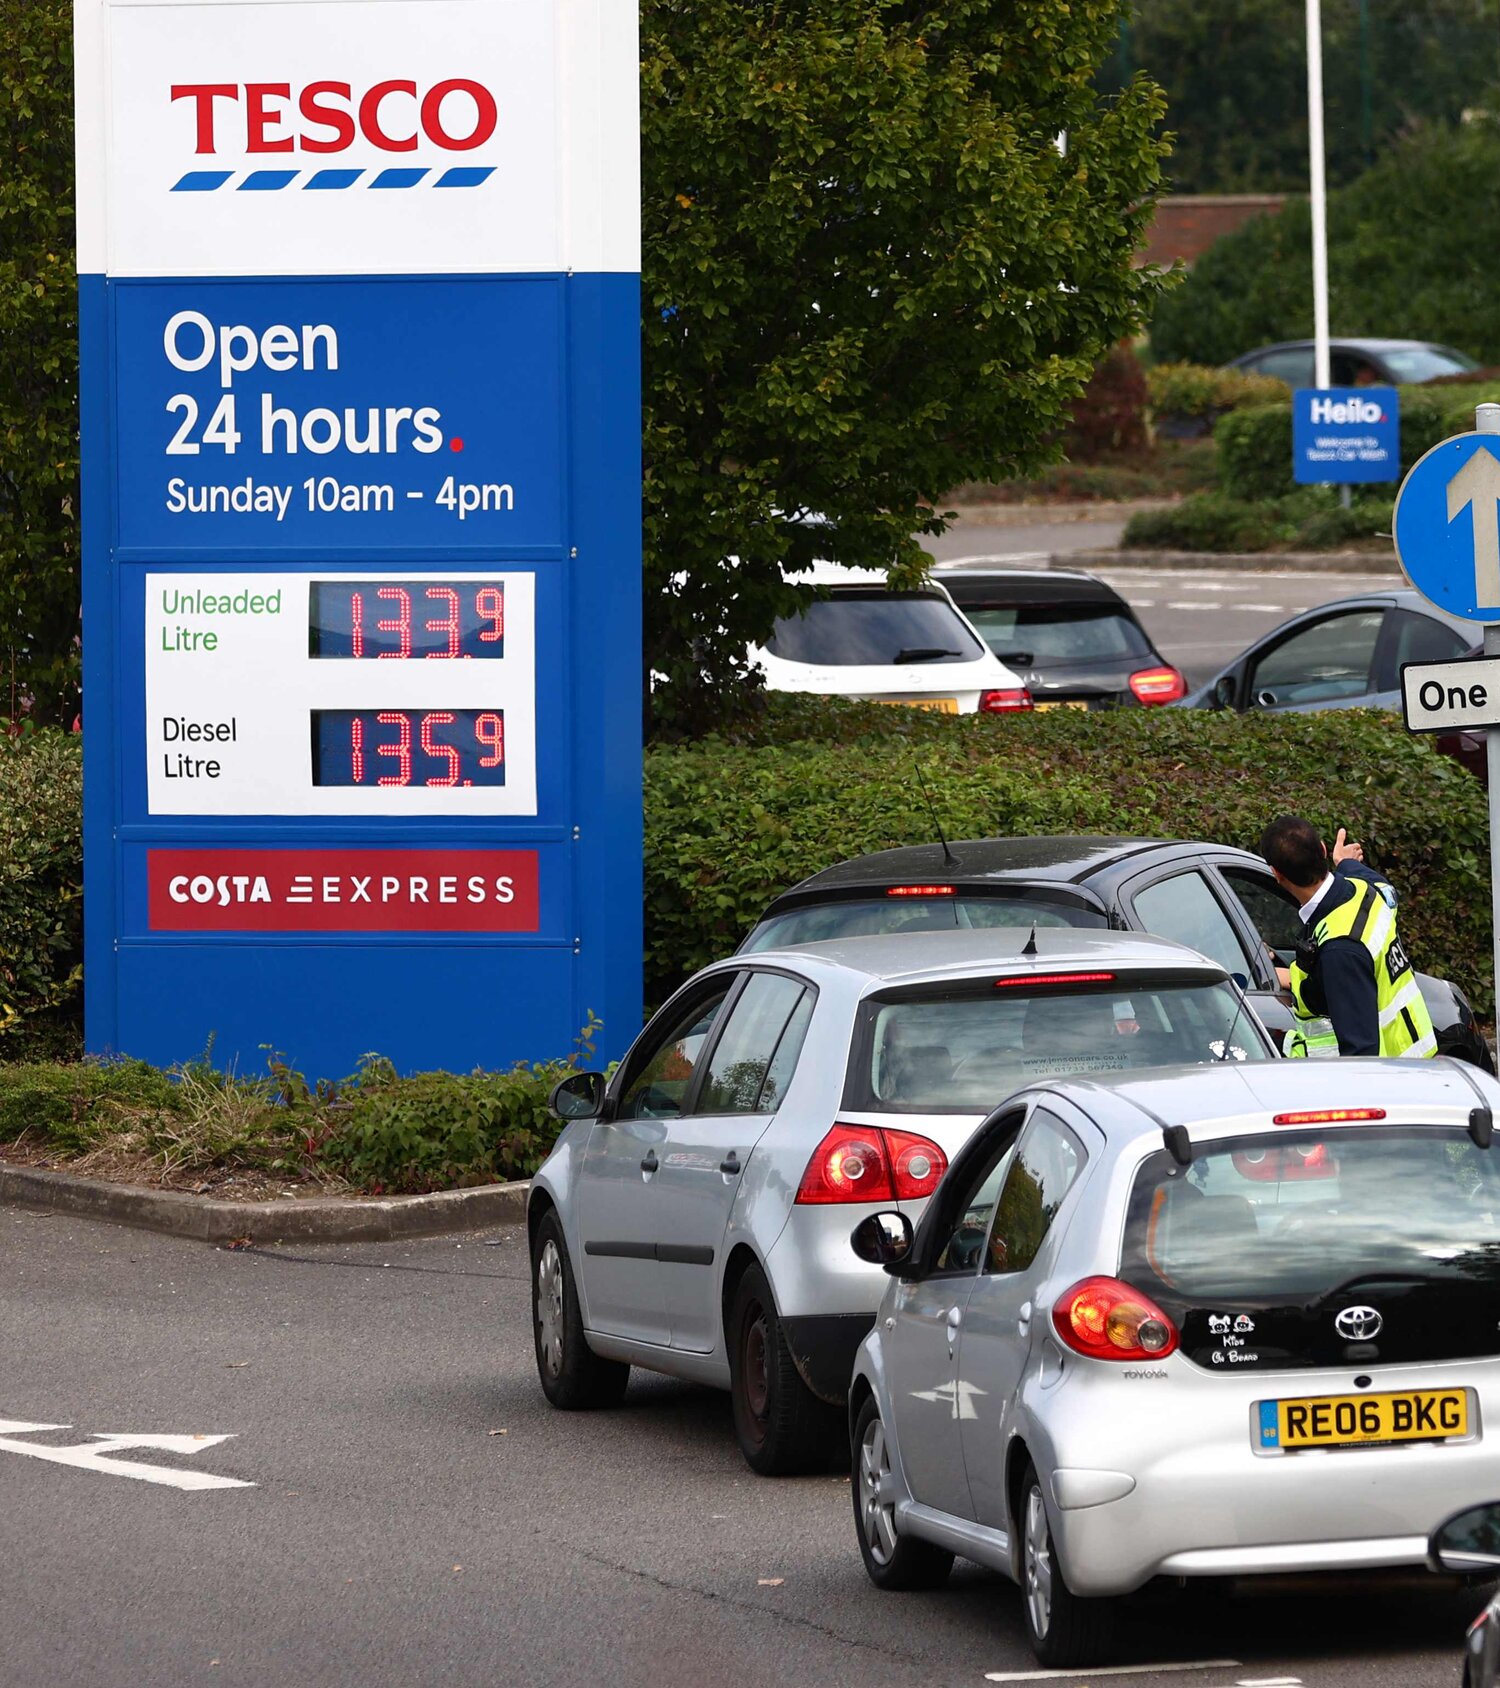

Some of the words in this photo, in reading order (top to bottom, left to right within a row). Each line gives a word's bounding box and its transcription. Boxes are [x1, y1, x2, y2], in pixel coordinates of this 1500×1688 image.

[170, 78, 498, 154] TESCO
[163, 310, 339, 387] Open
[165, 393, 241, 455] 24
[262, 393, 464, 455] hours.
[165, 475, 291, 522] Sunday
[304, 476, 394, 513] 10am
[435, 475, 514, 519] 4pm
[161, 588, 282, 616] Unleaded
[161, 625, 219, 652] Litre
[351, 586, 504, 659] 133.9
[1418, 680, 1488, 711] One
[162, 716, 237, 743] Diesel
[163, 753, 222, 780] Litre
[351, 712, 504, 787] 135.9
[168, 874, 272, 907] COSTA
[322, 874, 516, 905] EXPRESS
[1121, 1368, 1169, 1380] TOYOTA
[1286, 1400, 1382, 1439] RE06
[1392, 1395, 1461, 1433] BKG
